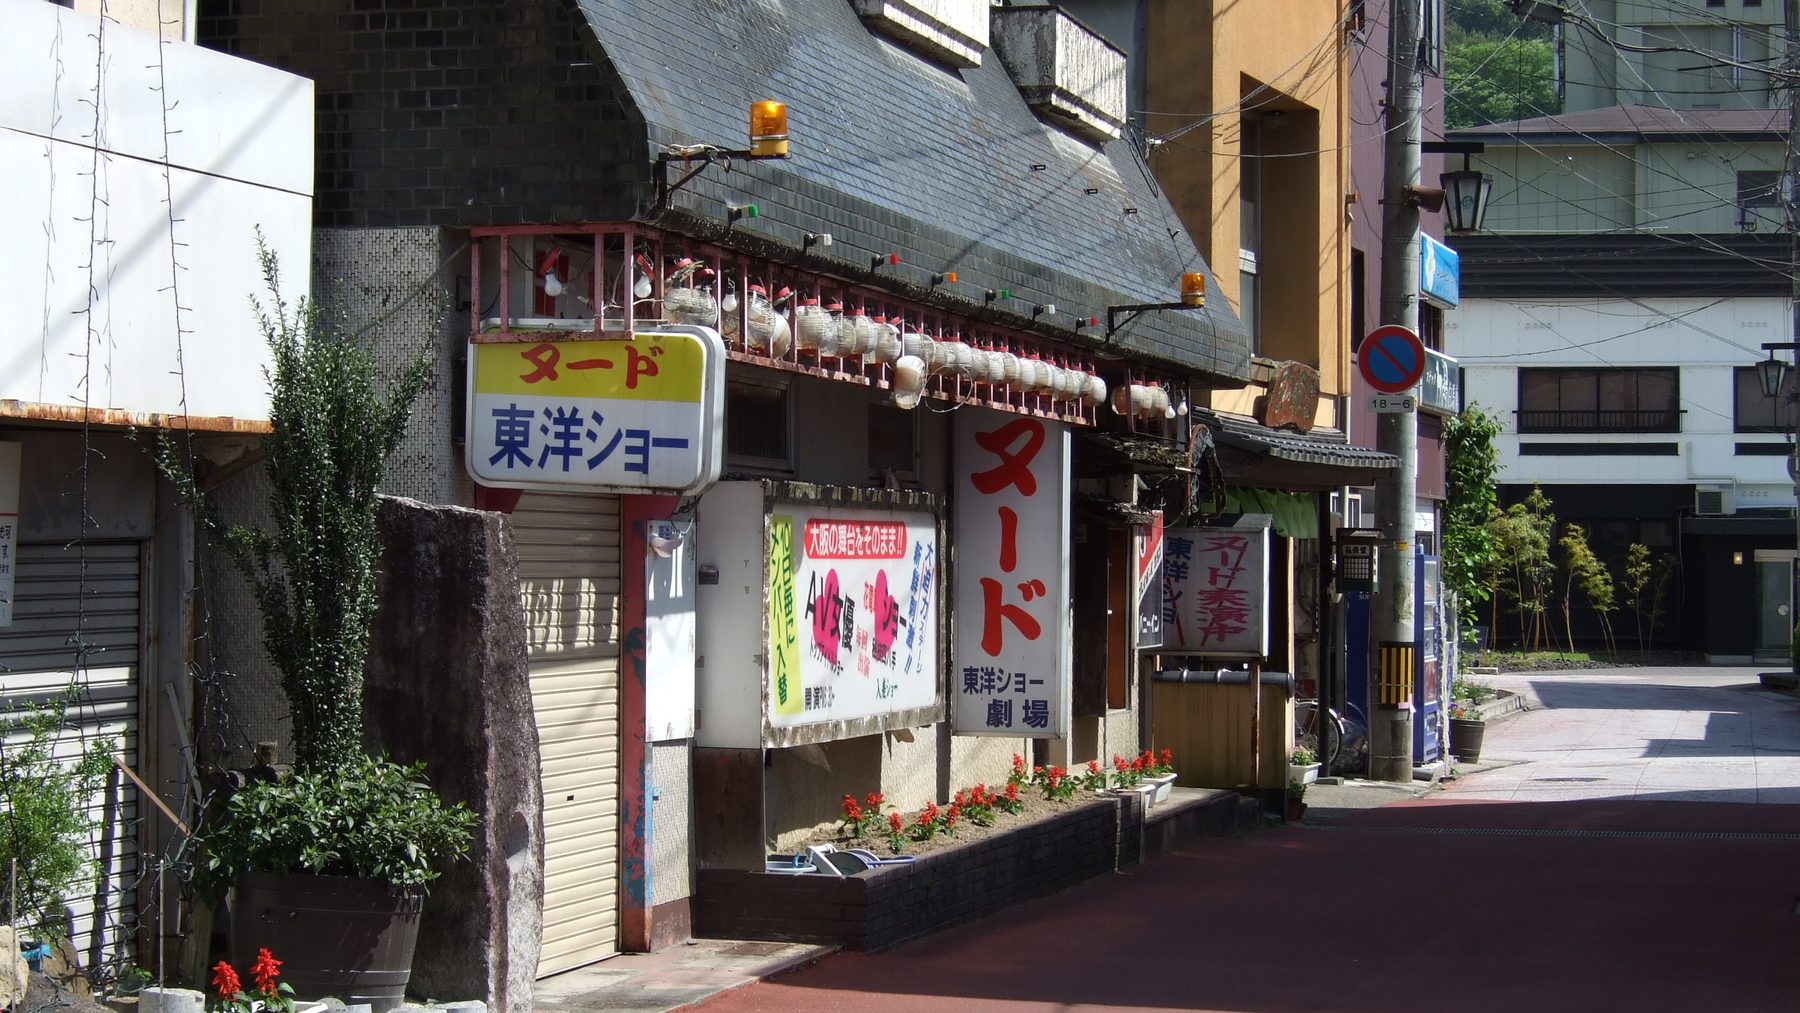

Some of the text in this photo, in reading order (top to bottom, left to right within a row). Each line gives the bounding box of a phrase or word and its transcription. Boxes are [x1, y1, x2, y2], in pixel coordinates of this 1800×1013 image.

[519, 343, 664, 389] ヌード
[489, 403, 689, 475] 東洋ショー
[970, 417, 1046, 657] ヌード
[962, 666, 1044, 695] 東洋ショー
[986, 699, 1050, 729] 劇場
